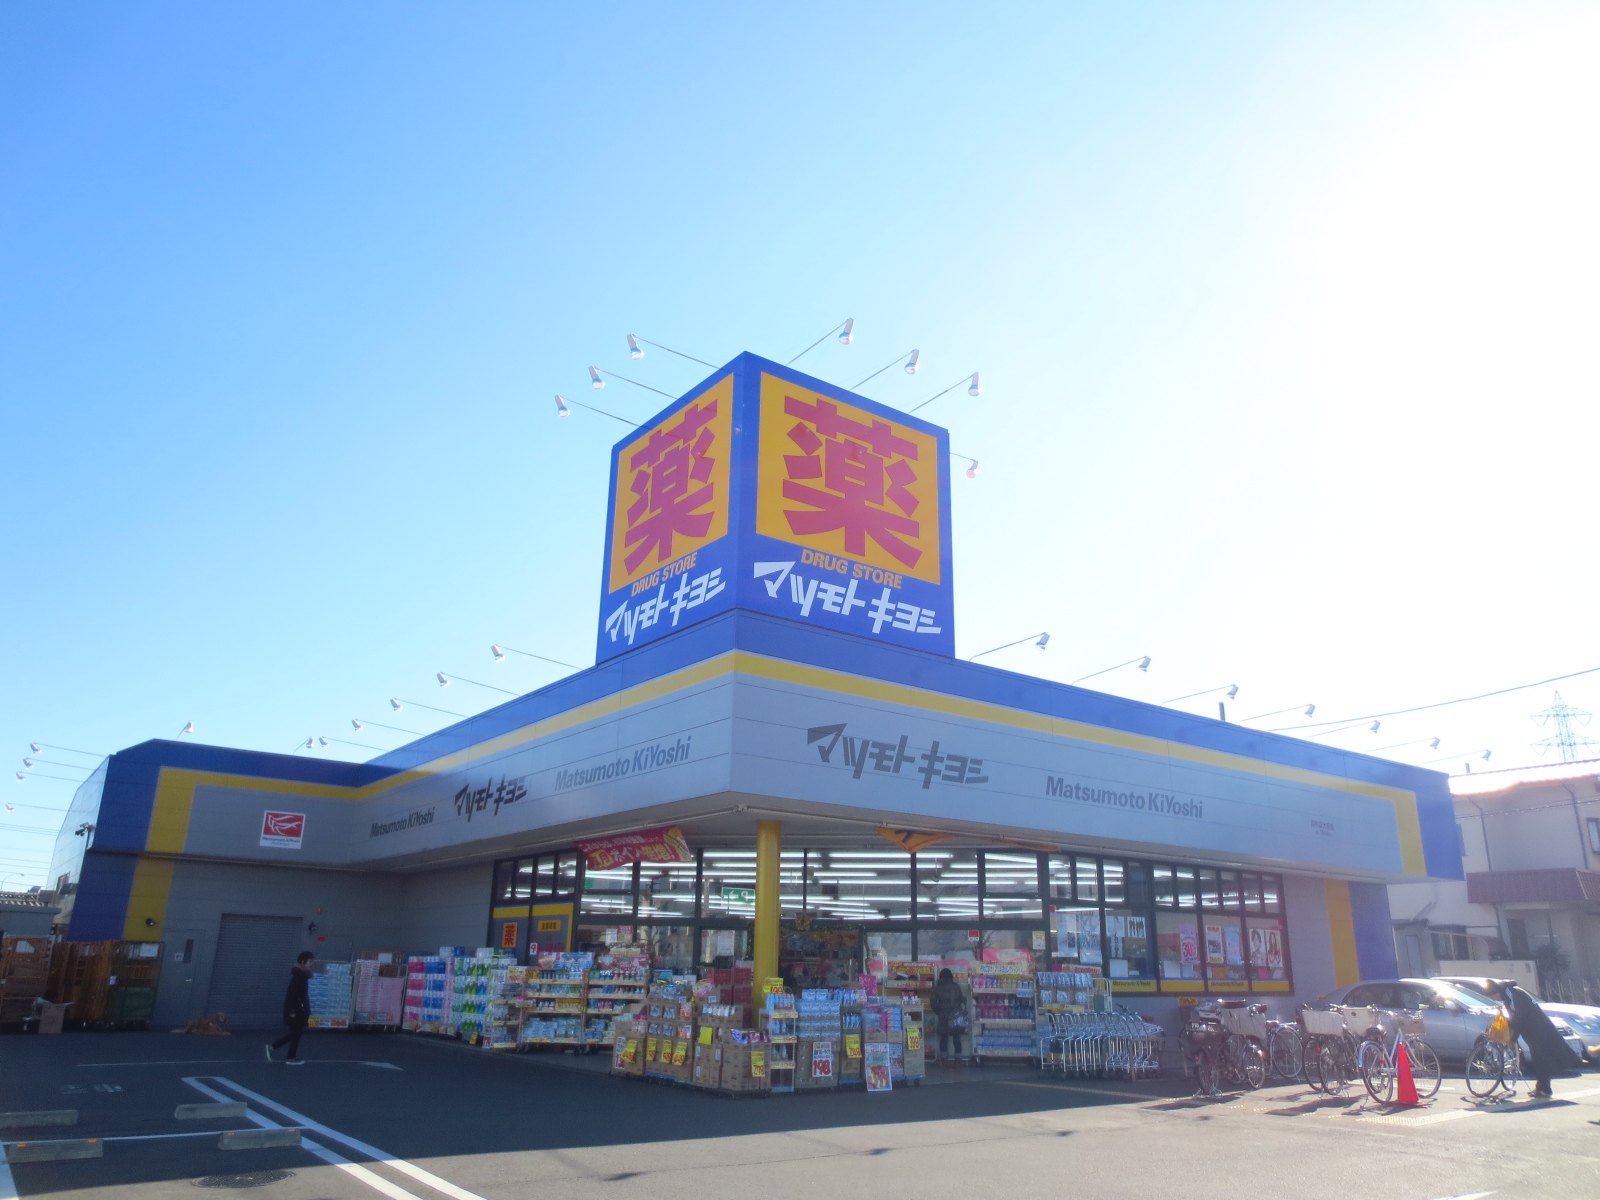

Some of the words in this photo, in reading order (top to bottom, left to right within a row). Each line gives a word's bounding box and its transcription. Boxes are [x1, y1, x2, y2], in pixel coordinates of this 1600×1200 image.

[623, 398, 718, 576] 薬
[783, 395, 922, 569] 薬
[631, 573, 660, 597] DRUG
[662, 552, 698, 582] STORE
[753, 561, 941, 634] マツモトキヨシ
[801, 549, 848, 574] DRUG
[853, 564, 903, 589] STORE
[605, 567, 726, 645] マツモトキヨシ
[806, 722, 989, 789] マツモトキヨシ
[454, 775, 527, 822] マツモトキヨシ
[813, 1059, 831, 1076] 198
